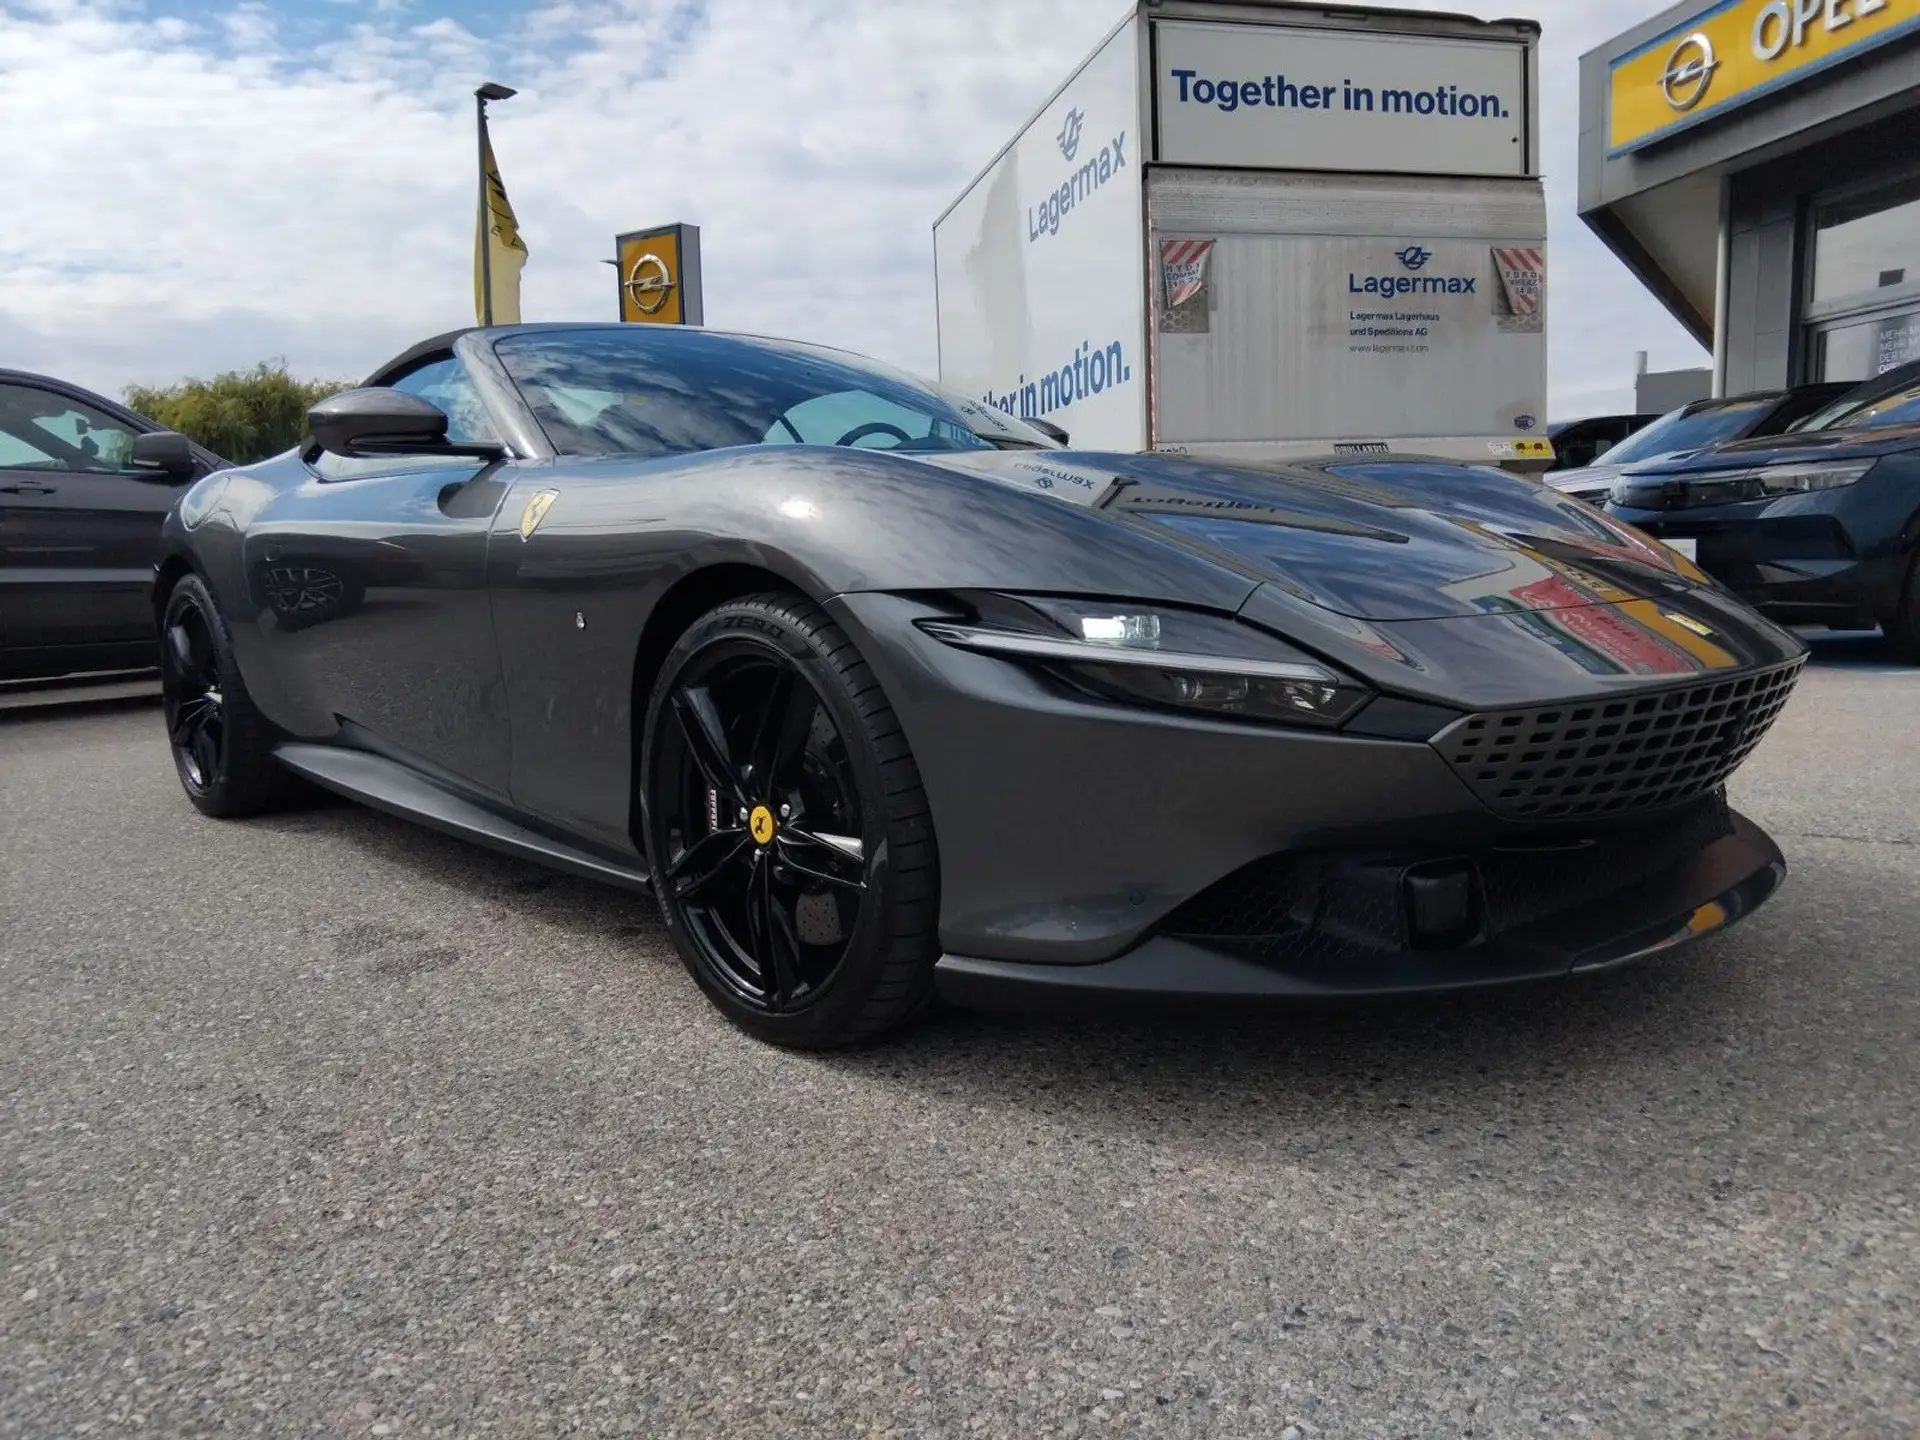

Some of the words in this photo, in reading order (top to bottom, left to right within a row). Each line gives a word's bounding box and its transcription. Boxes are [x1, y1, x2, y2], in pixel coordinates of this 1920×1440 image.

[1171, 69, 1336, 112] Together
[1343, 79, 1374, 112] in
[1382, 85, 1509, 118] motion.
[1029, 130, 1126, 243] Lagermax
[1348, 273, 1476, 298] Lagermax
[1349, 311, 1394, 322] Lagermax
[1395, 312, 1440, 322] Lagerhaus
[1349, 327, 1366, 336] und
[1414, 327, 1428, 336] AG
[1019, 374, 1037, 418] in
[1041, 340, 1131, 416] motion.
